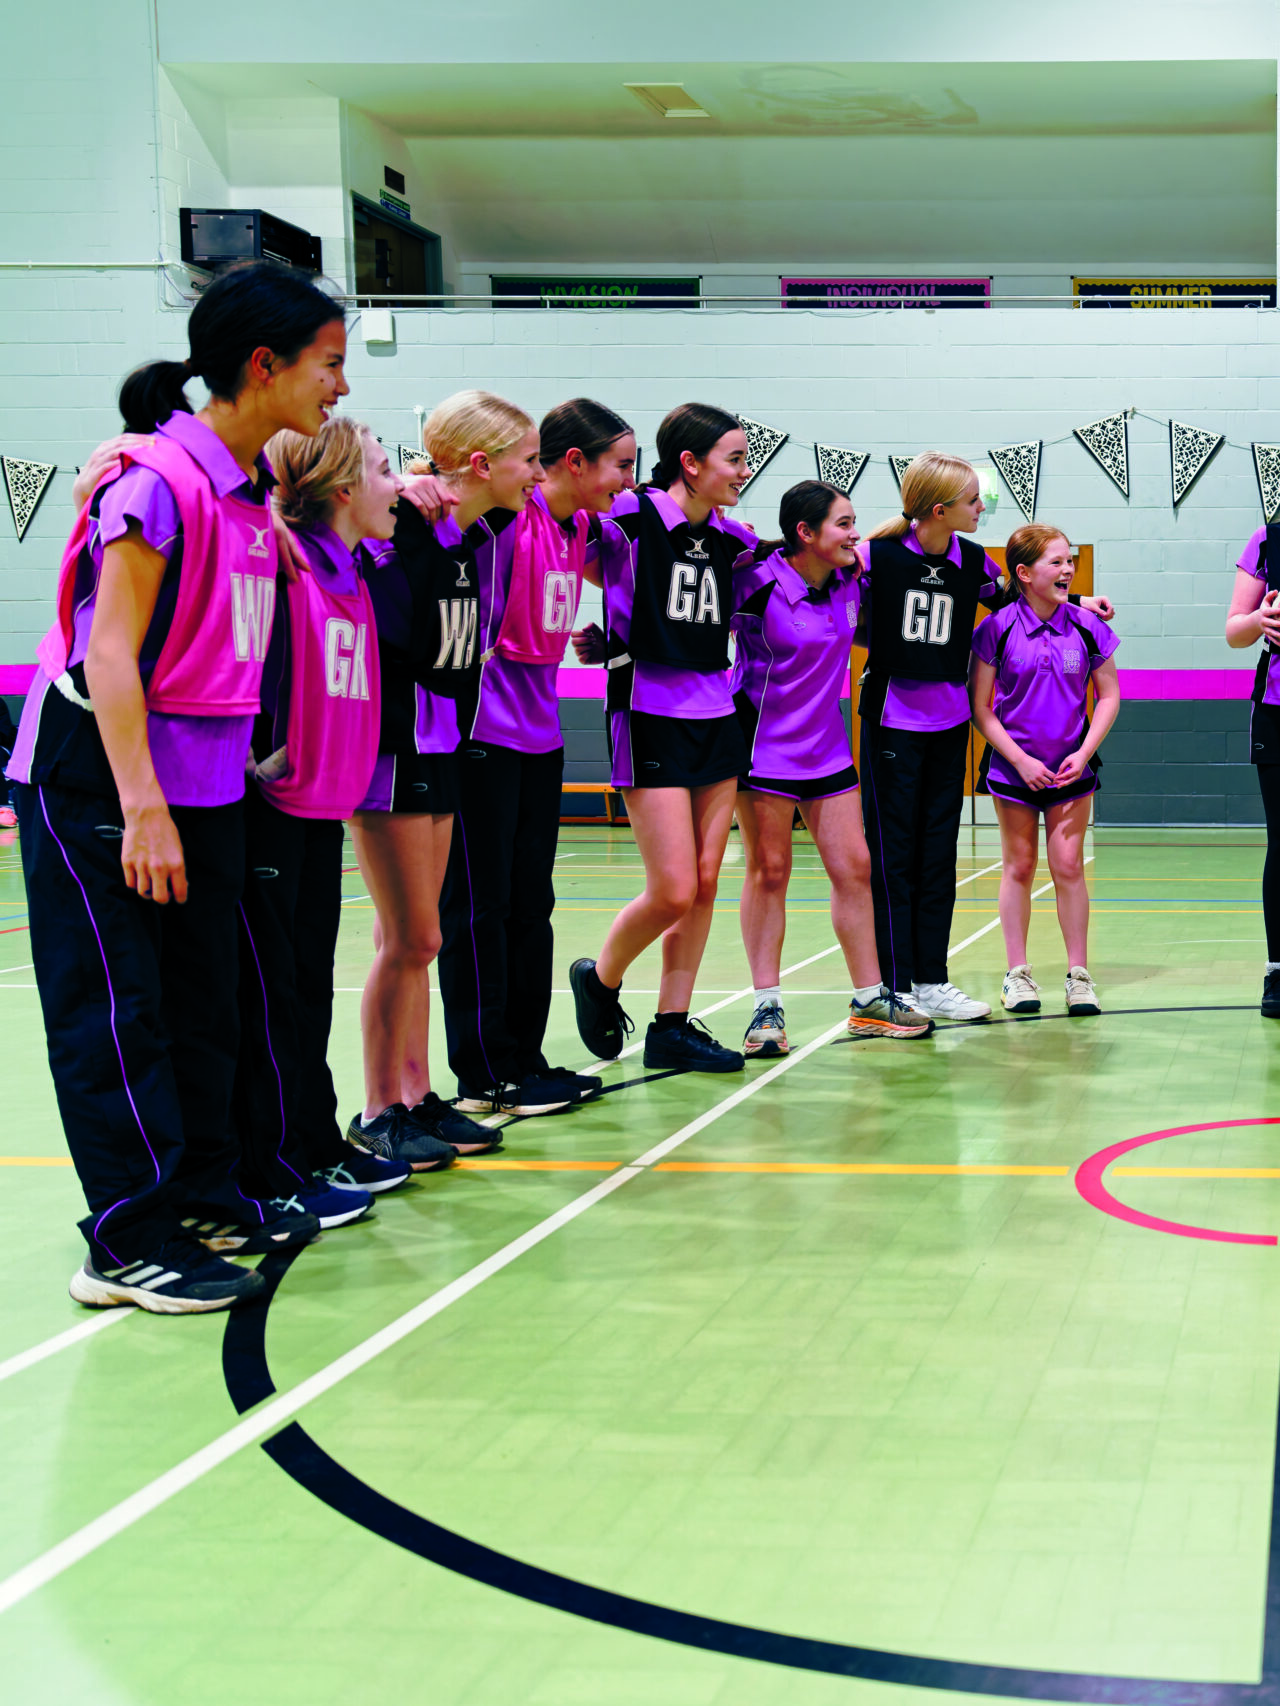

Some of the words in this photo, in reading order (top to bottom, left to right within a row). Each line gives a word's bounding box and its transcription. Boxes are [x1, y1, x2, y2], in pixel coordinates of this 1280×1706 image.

[540, 285, 638, 307] INVASION
[826, 285, 941, 307] INDIVIDUAL
[1130, 286, 1212, 308] SUMMER
[667, 561, 721, 624] GA
[902, 589, 954, 645] GD
